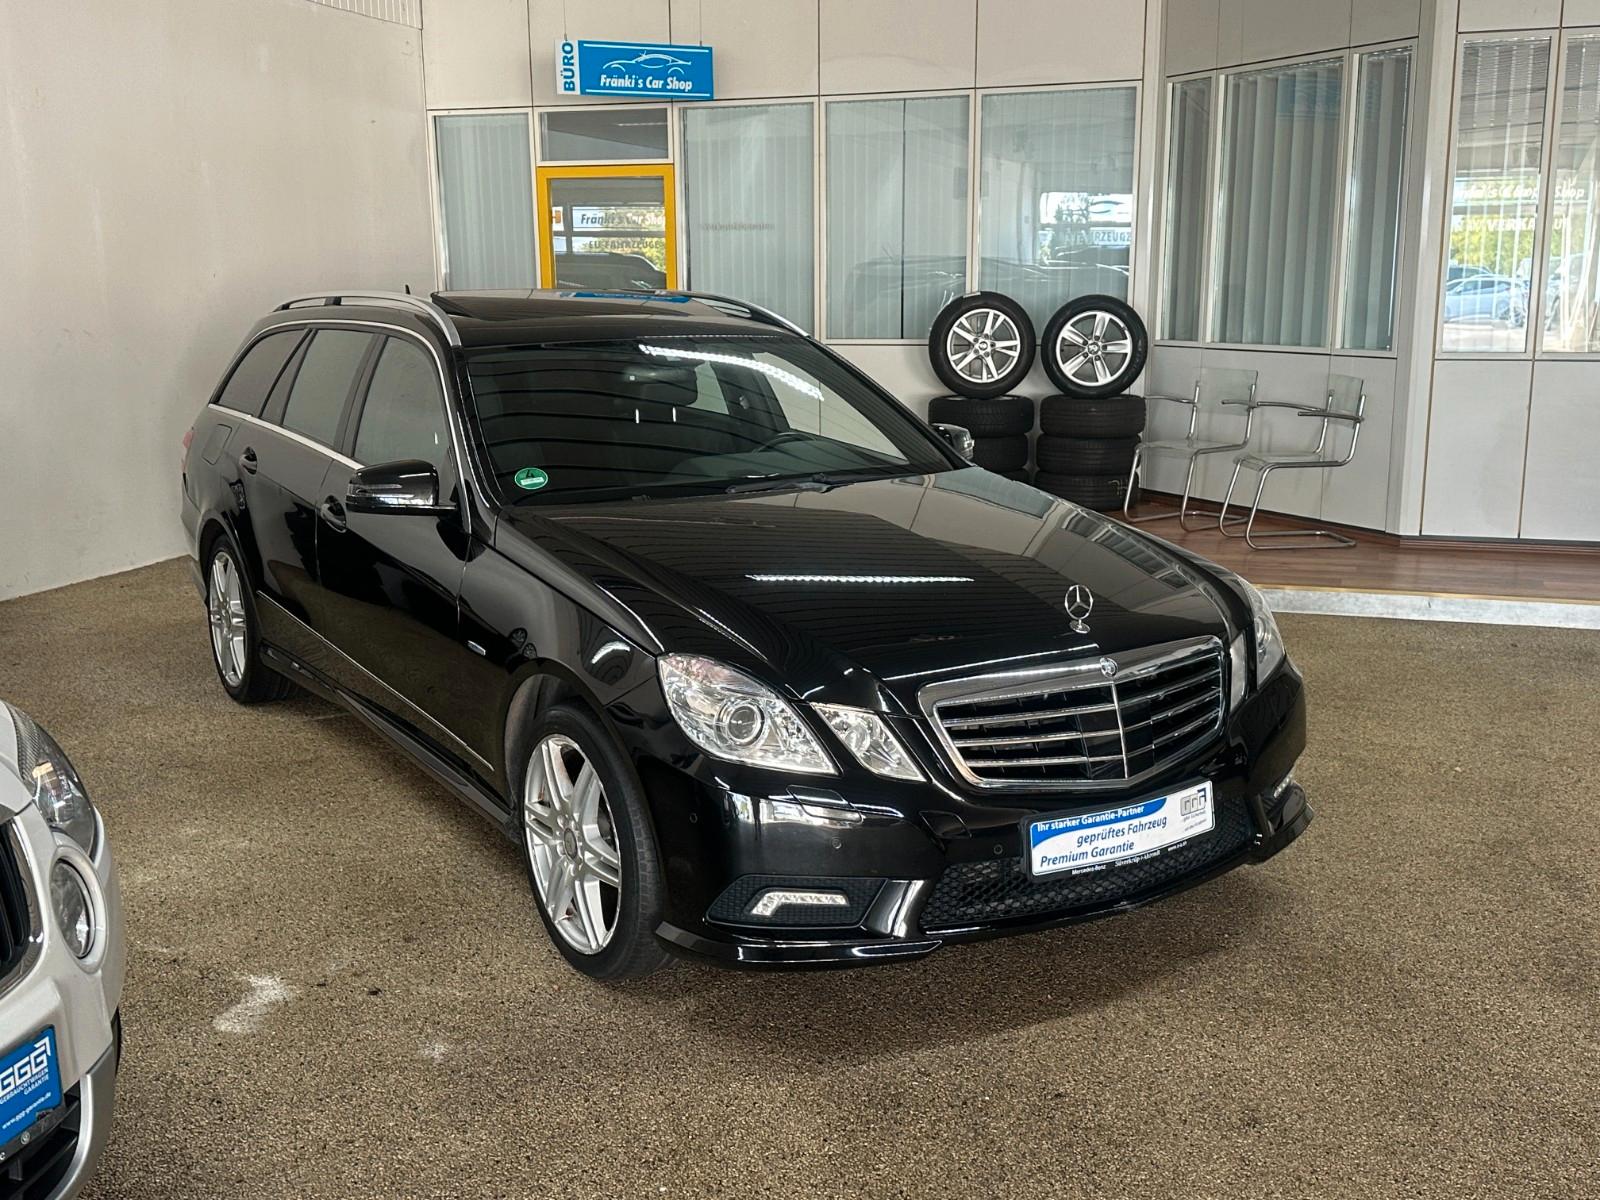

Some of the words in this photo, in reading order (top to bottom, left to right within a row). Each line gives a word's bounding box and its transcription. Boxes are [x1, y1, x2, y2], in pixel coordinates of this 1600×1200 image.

[561, 42, 575, 92] BÜRO
[600, 74, 643, 89] Fränki's
[645, 76, 663, 89] Car
[666, 77, 693, 92] Shop
[1037, 821, 1050, 832] Ihr
[1050, 817, 1080, 831] starker
[1081, 805, 1145, 825] Garantie-Partner
[1077, 826, 1125, 847] geprüftes
[1127, 815, 1168, 835] Fahrzeug
[1040, 848, 1089, 867] Premium
[1091, 840, 1135, 859] Garantie
